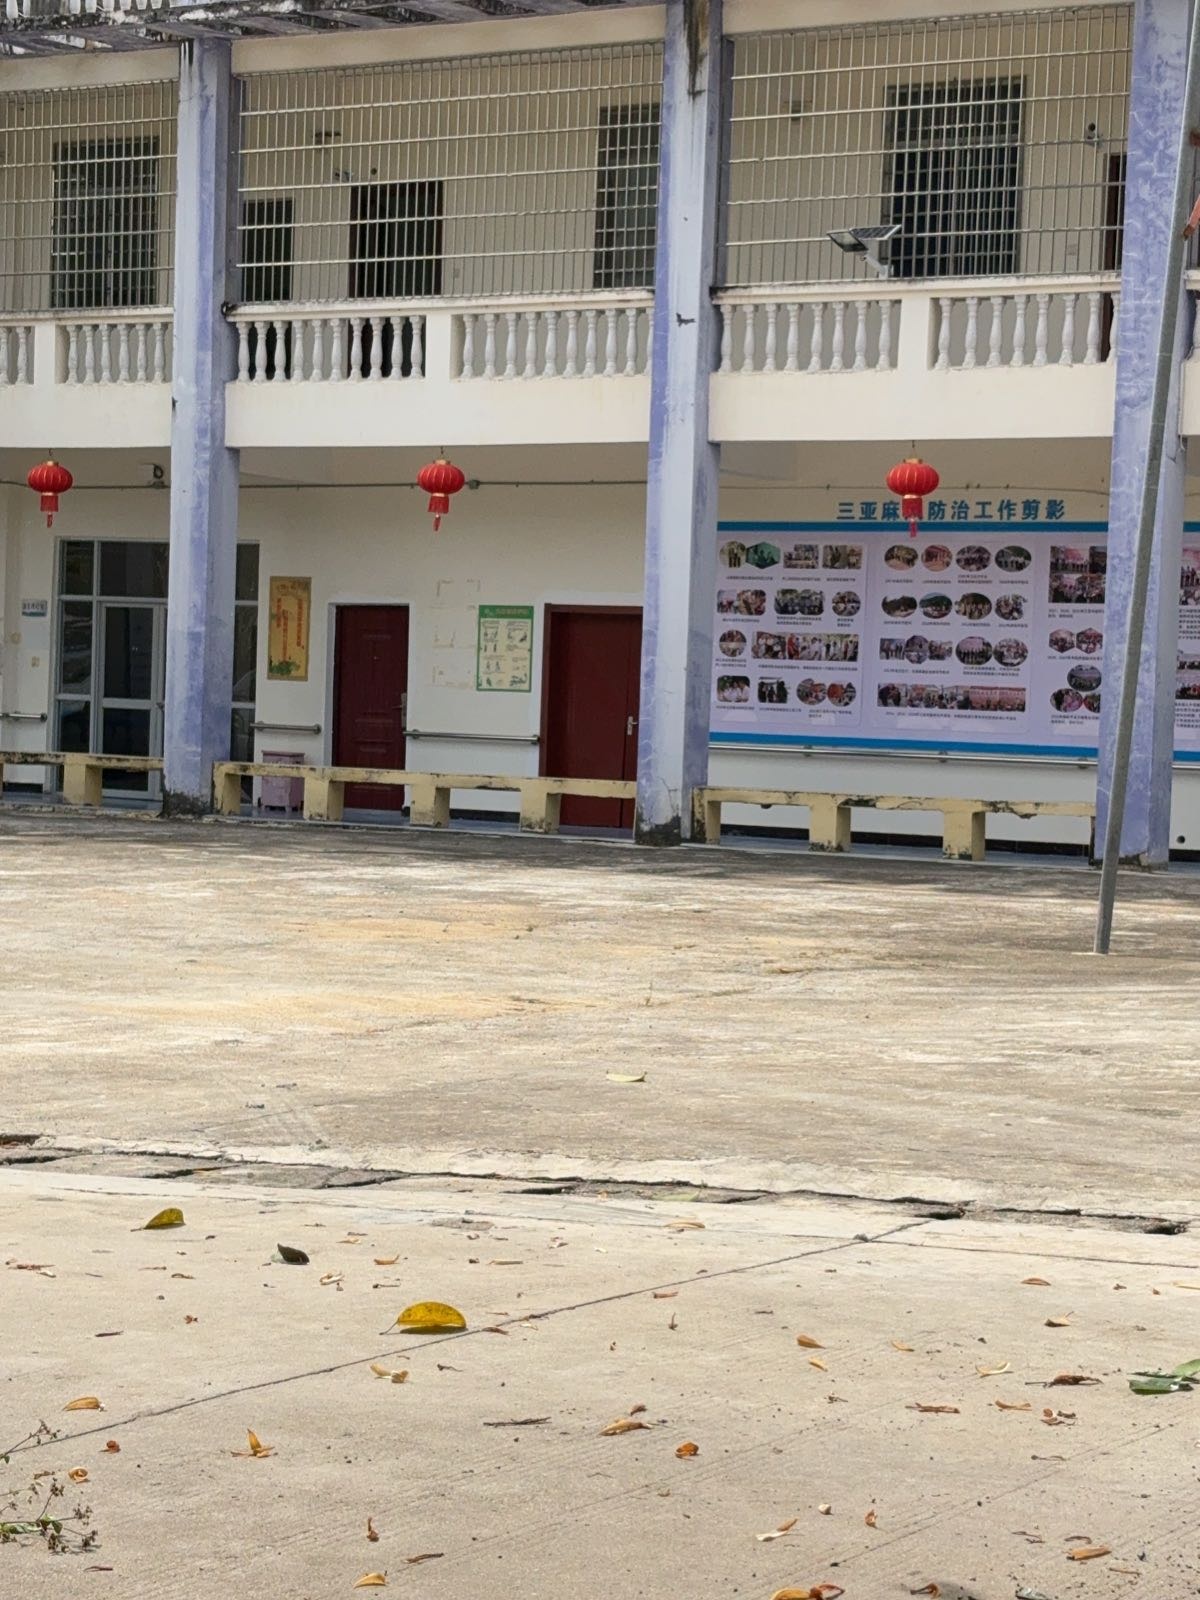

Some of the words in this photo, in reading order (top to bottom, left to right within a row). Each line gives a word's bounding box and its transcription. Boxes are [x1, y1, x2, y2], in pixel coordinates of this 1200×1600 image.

[837, 499, 1065, 521] 三亚麻防治工作剪影
